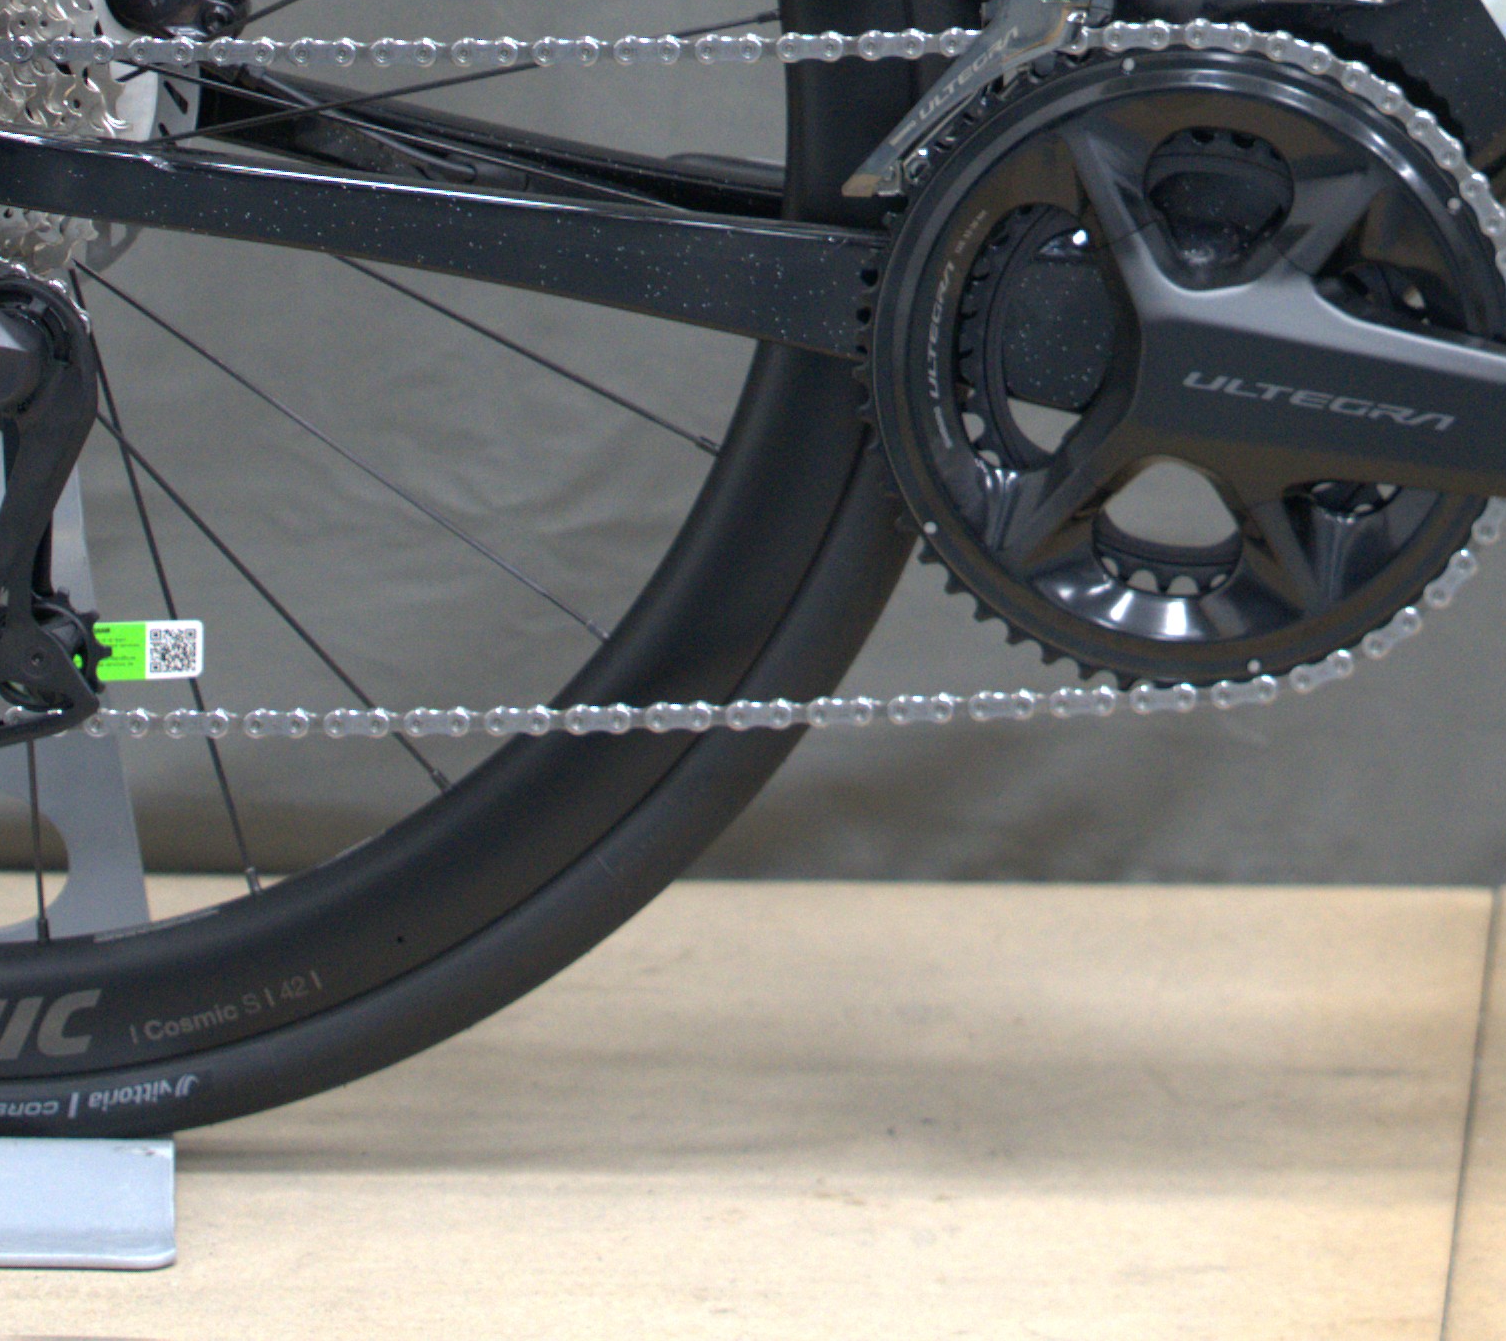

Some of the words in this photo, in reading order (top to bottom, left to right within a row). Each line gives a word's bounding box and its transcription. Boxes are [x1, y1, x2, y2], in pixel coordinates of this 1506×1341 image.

[918, 25, 1020, 120] ULTEGRA
[926, 260, 955, 400] ULTEGRA
[1182, 370, 1455, 433] ULTEGRA
[144, 1003, 238, 1041] Cosmic
[243, 993, 261, 1015] S
[278, 975, 309, 1001] 42
[87, 1078, 173, 1113] vittoria
